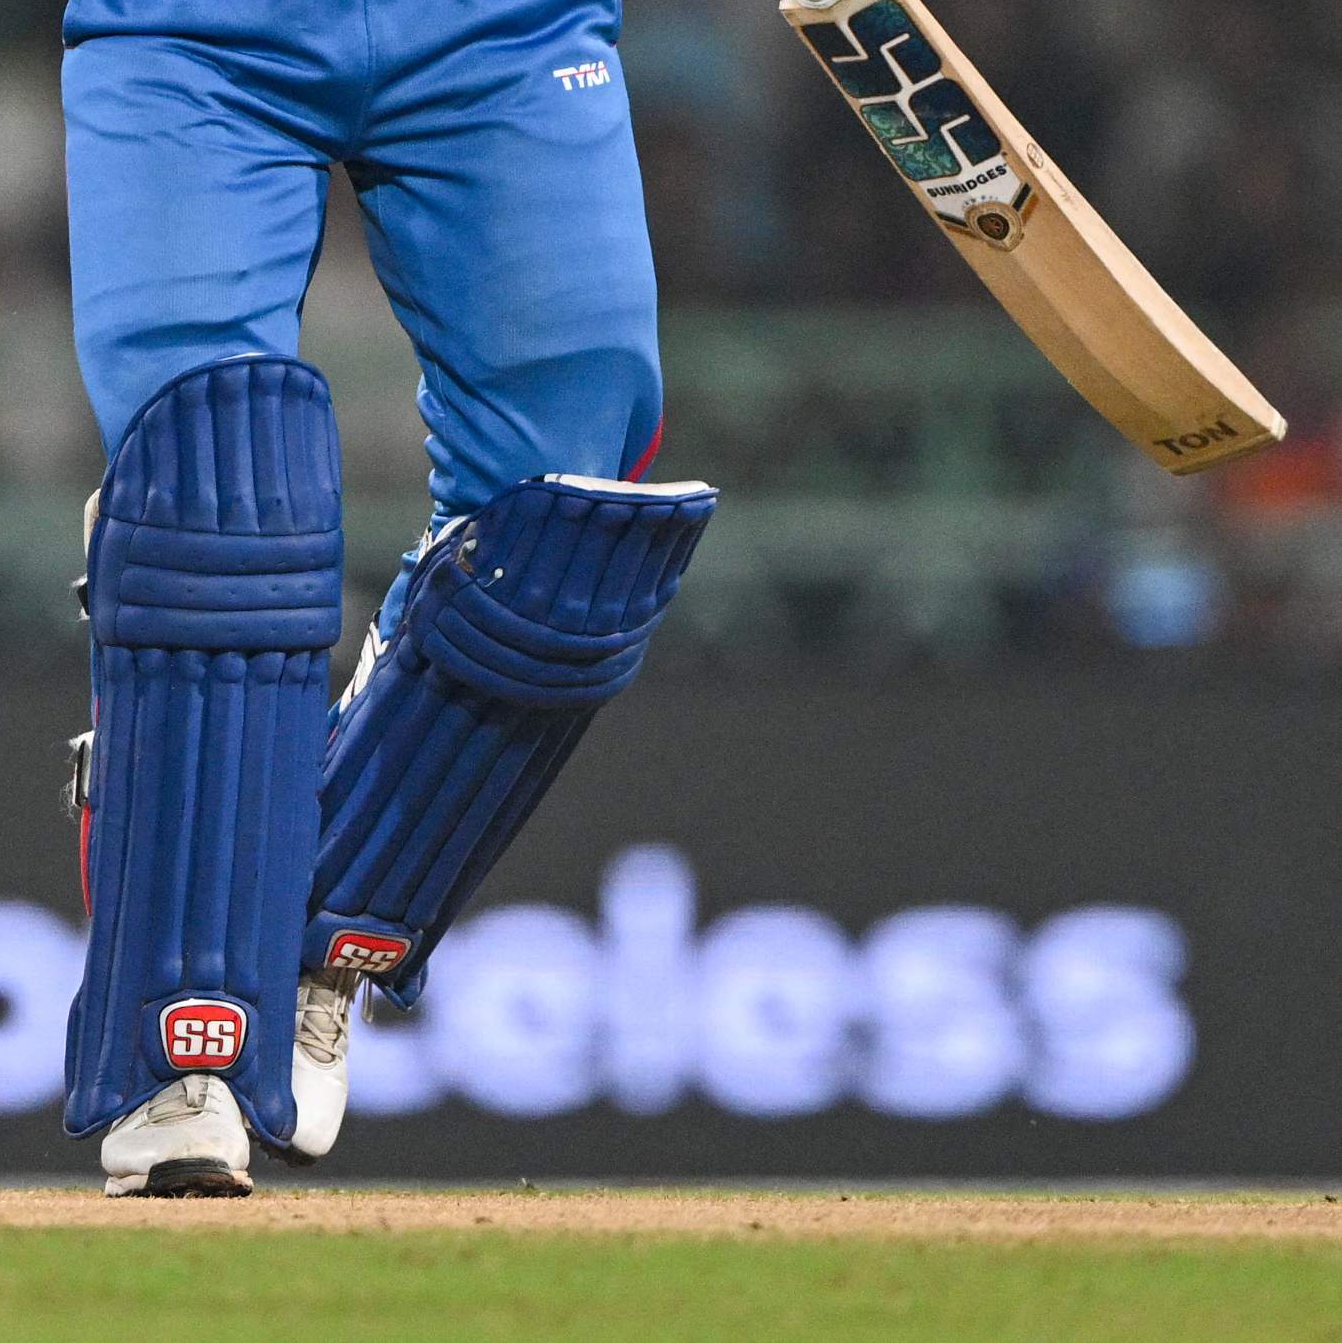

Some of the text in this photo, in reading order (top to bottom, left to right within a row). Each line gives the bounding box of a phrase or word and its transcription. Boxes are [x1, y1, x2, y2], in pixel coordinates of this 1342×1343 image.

[926, 163, 1007, 198] SUNRIDGES
[1153, 420, 1239, 455] TON
[332, 943, 398, 972] SS
[173, 1019, 235, 1056] SS
